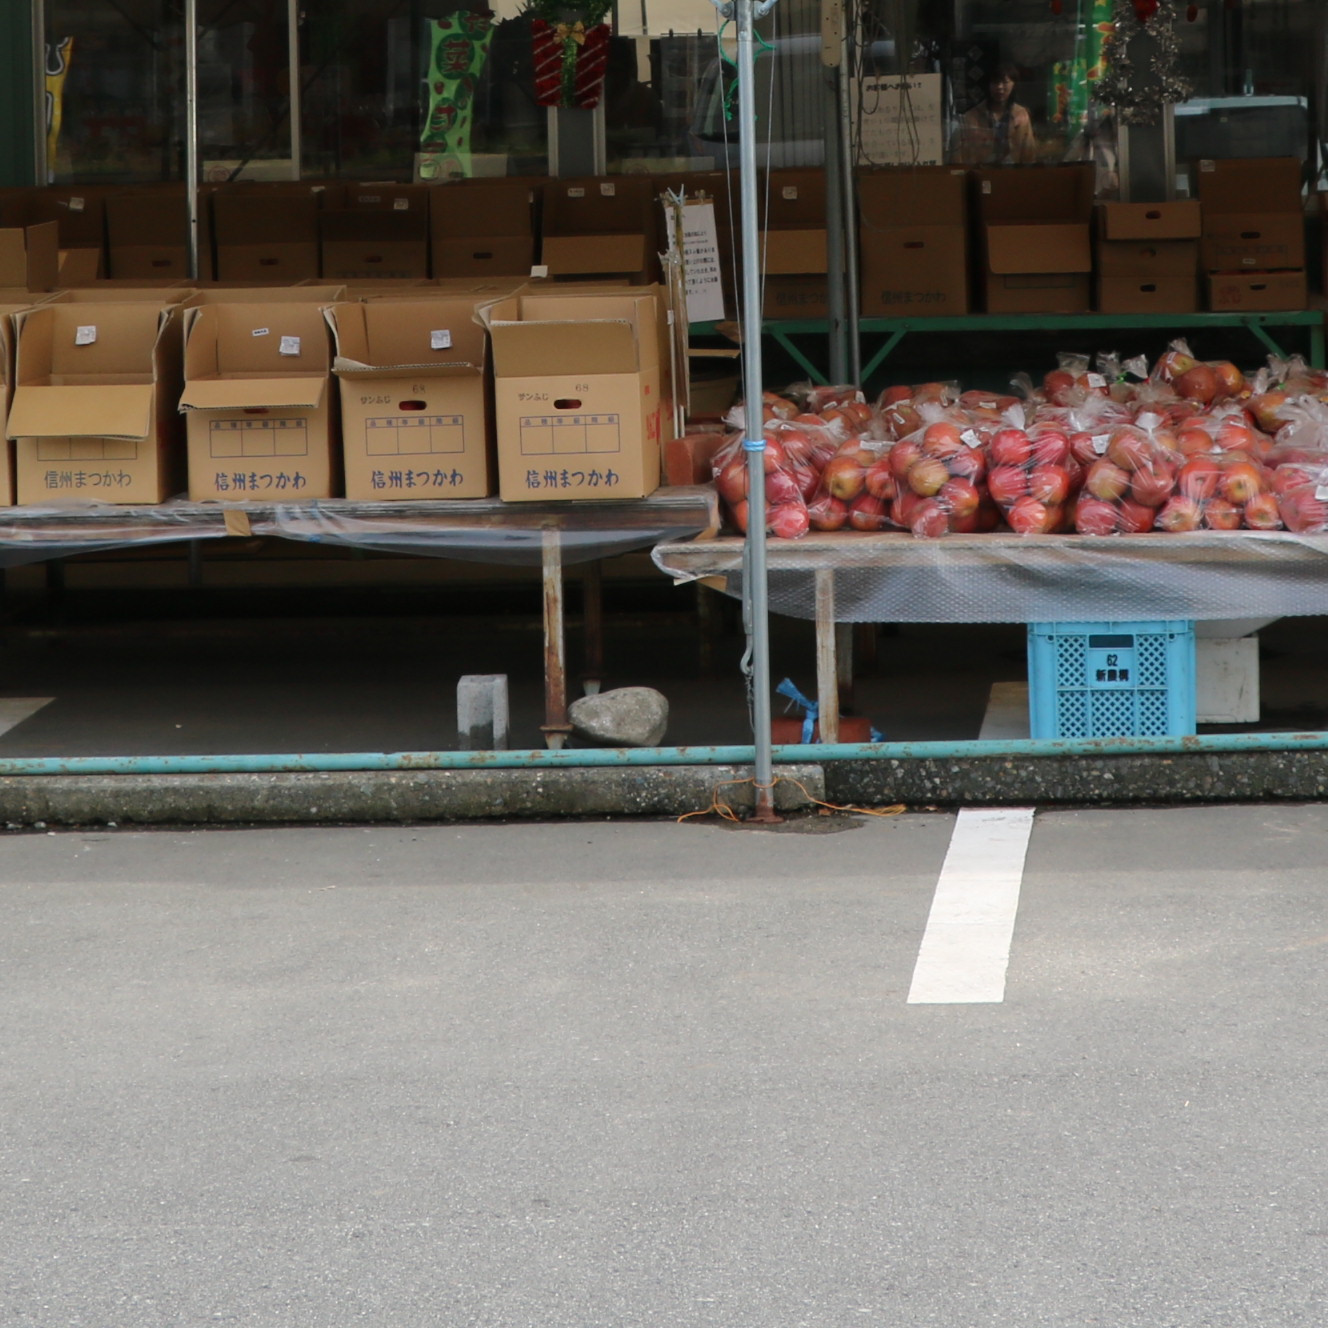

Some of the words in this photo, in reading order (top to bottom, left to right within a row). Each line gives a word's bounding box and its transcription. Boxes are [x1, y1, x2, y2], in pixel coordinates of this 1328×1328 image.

[44, 469, 132, 490] 信州まつかわ
[215, 471, 306, 491] 信州まつかわ
[371, 468, 464, 490] 信州まつかわ
[526, 468, 619, 489] 信州まつかわ
[1106, 654, 1118, 667] 62
